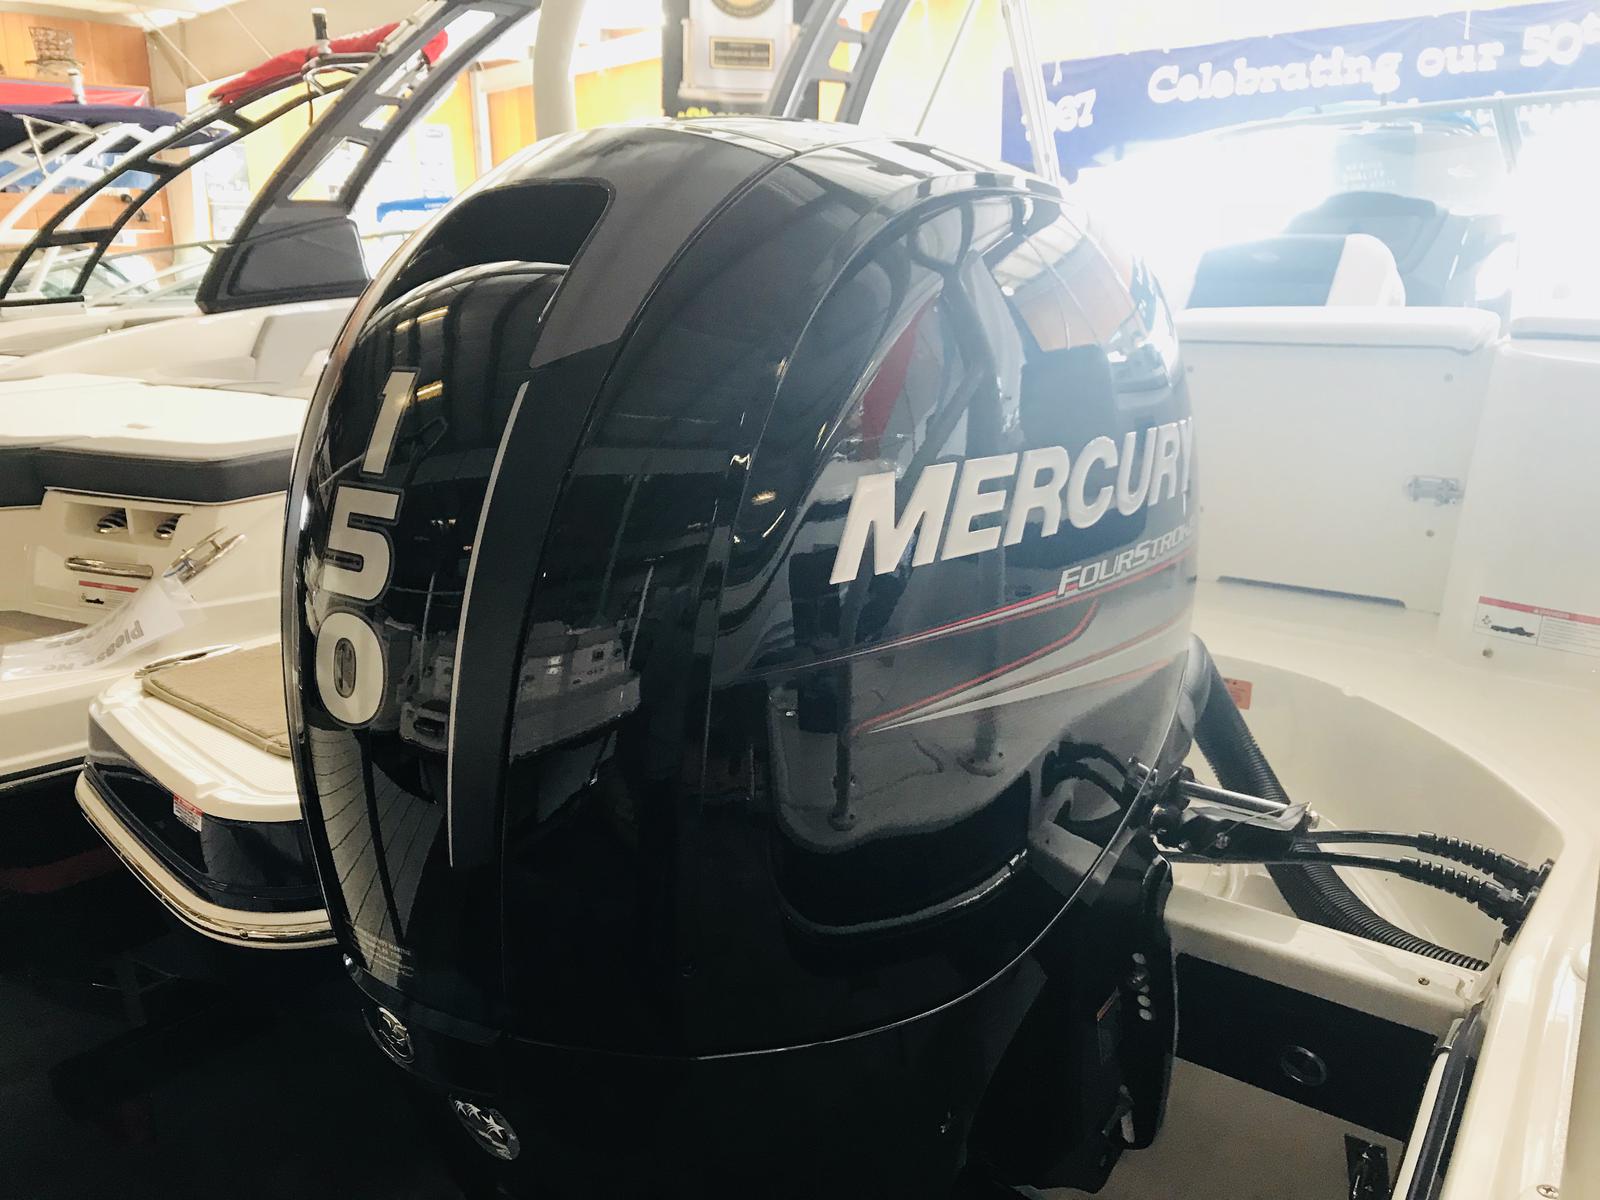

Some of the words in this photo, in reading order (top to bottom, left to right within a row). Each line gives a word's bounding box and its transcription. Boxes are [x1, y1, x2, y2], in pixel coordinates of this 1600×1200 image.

[1148, 46, 1403, 103] Celebrating
[1417, 39, 1504, 77] our
[315, 369, 418, 727] 150
[829, 416, 1192, 588] MERCURY
